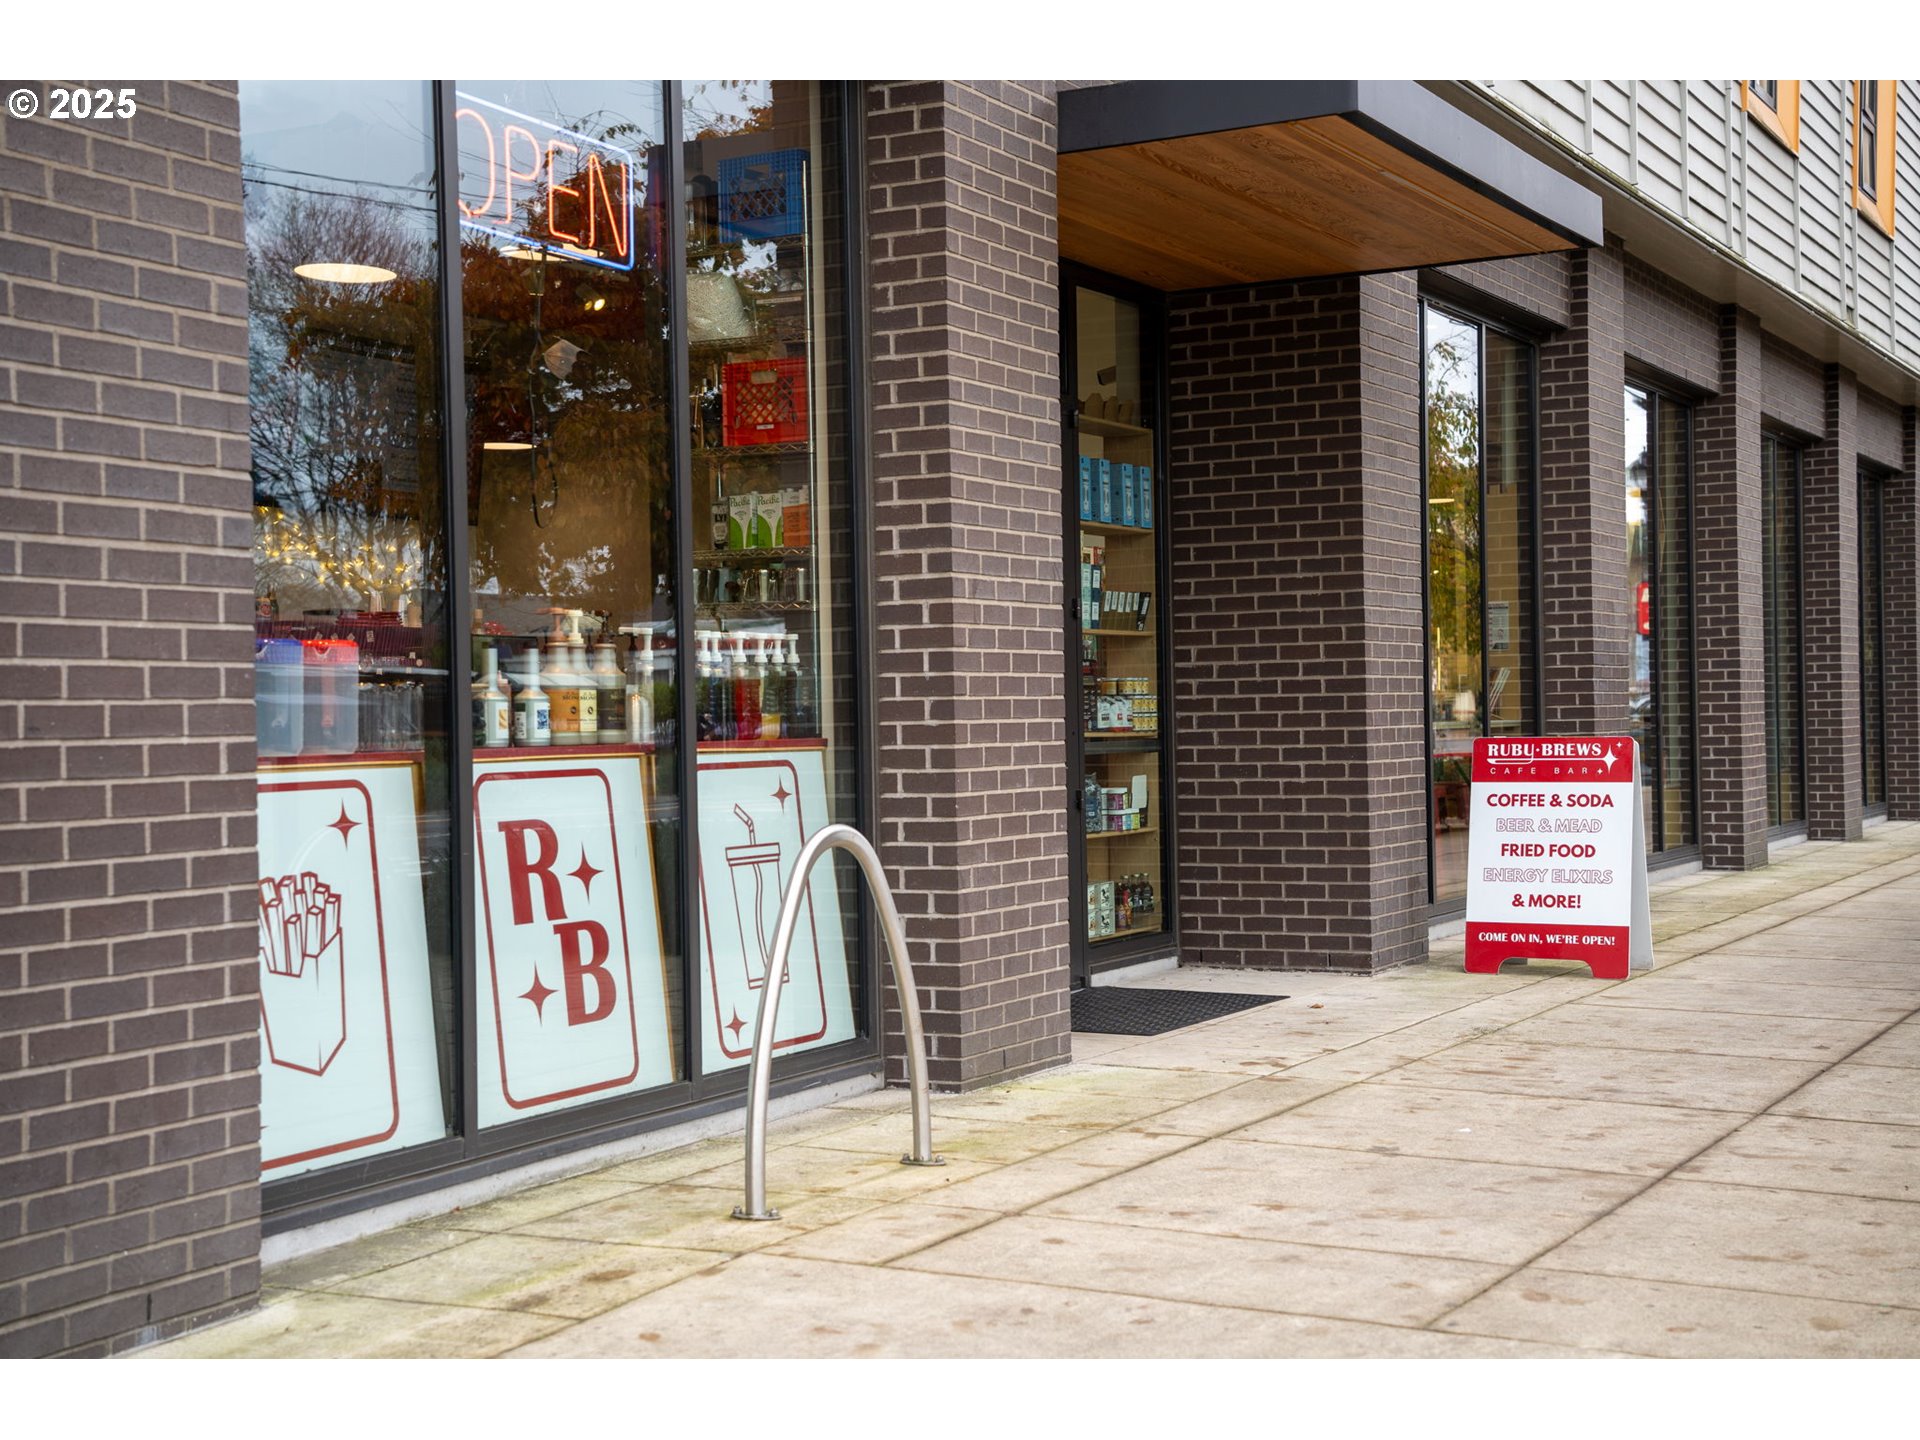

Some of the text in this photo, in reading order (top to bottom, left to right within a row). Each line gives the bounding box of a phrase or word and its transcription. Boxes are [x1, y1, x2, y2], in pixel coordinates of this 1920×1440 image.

[456, 109, 628, 257] OPEN
[757, 494, 780, 506] Pacific
[1487, 743, 1602, 762] RUBY BREWS
[1489, 767, 1588, 775] CAFE BAR
[1487, 794, 1614, 808] COFFEE & SODA
[1495, 818, 1603, 833] BEER & MEAD
[1501, 843, 1596, 858] FRIED FOOD
[497, 819, 568, 926] R
[1483, 867, 1614, 884] ENERGY ELIXIRS
[1511, 893, 1582, 909] & MORE!
[1478, 931, 1616, 946] COME ON IN, WE'RE OPEN!
[552, 919, 617, 1027] B
